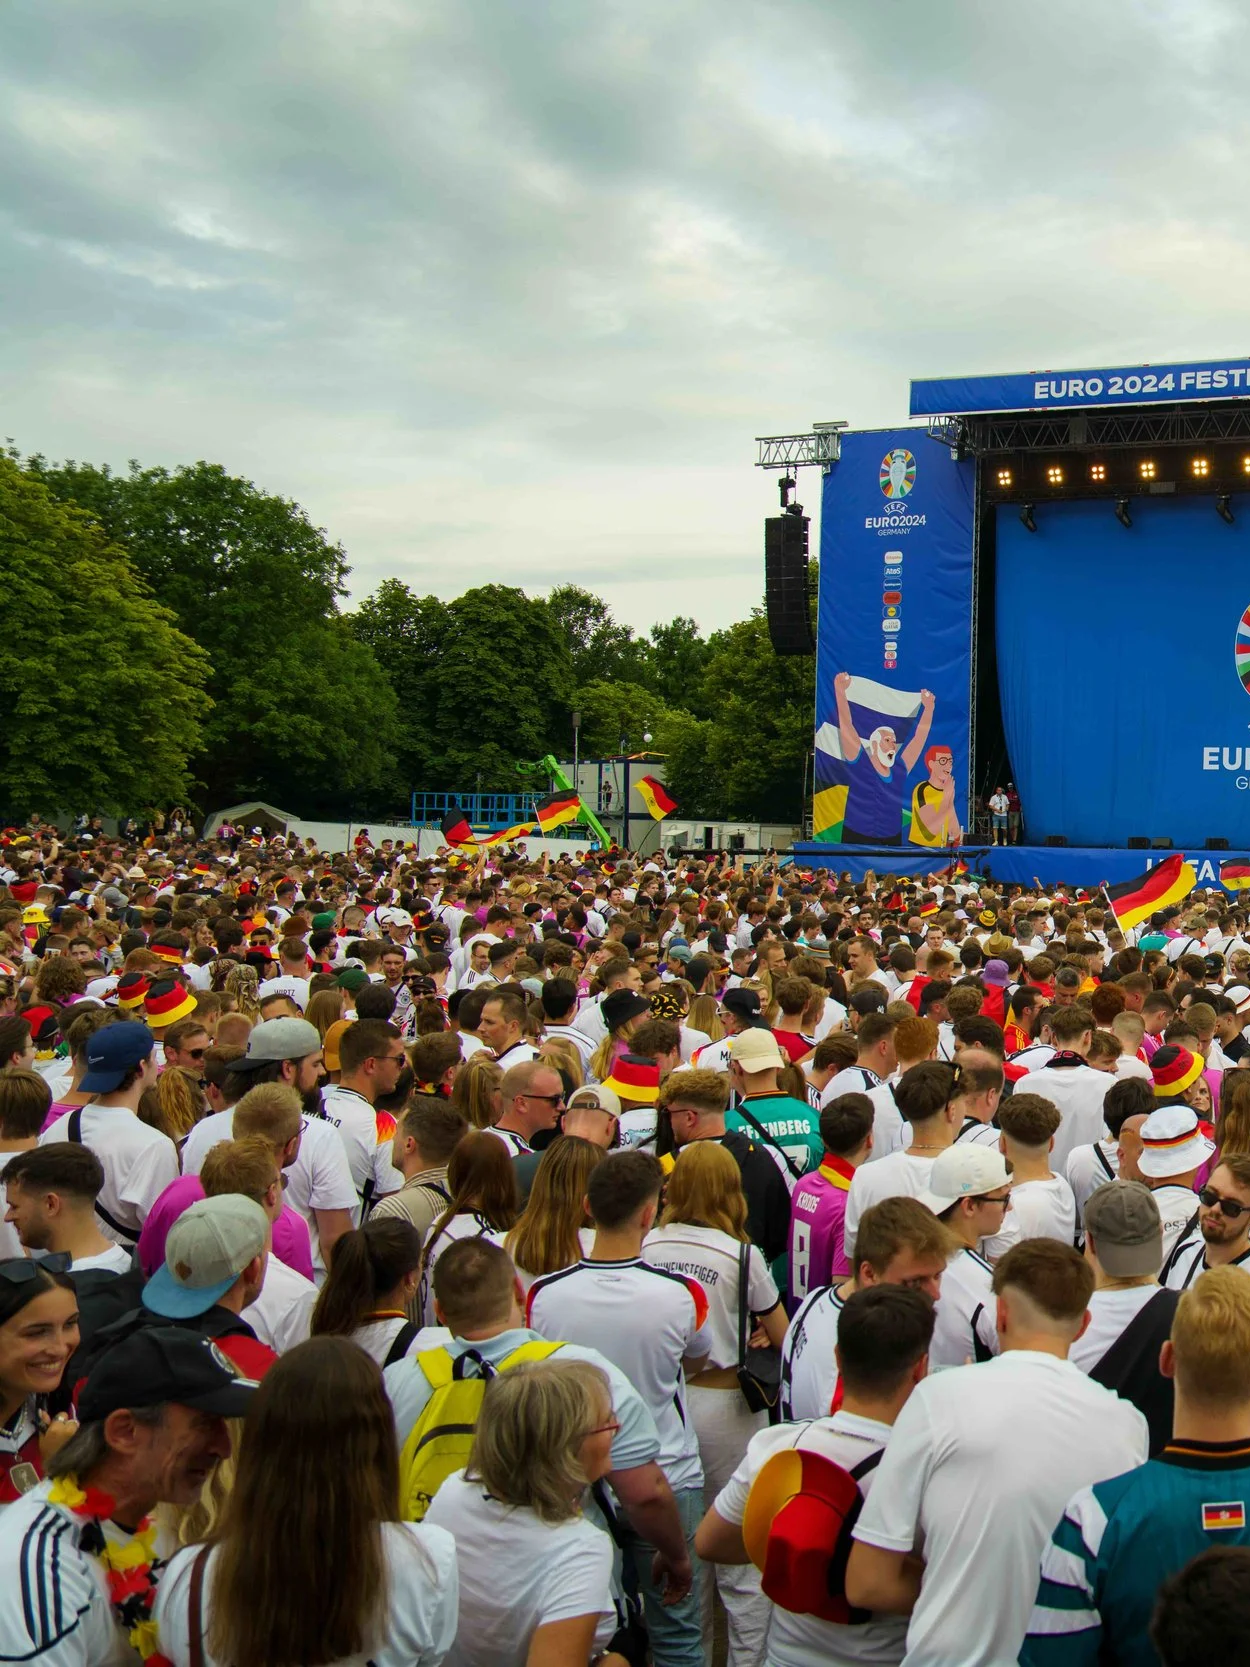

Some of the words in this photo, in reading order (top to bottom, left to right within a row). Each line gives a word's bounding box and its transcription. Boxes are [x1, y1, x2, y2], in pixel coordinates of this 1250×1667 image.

[1034, 378, 1103, 400] EURO
[1108, 374, 1175, 395] 2024
[884, 503, 906, 513] UEFA
[865, 515, 927, 528] EURO2024
[877, 528, 912, 536] GERMANY
